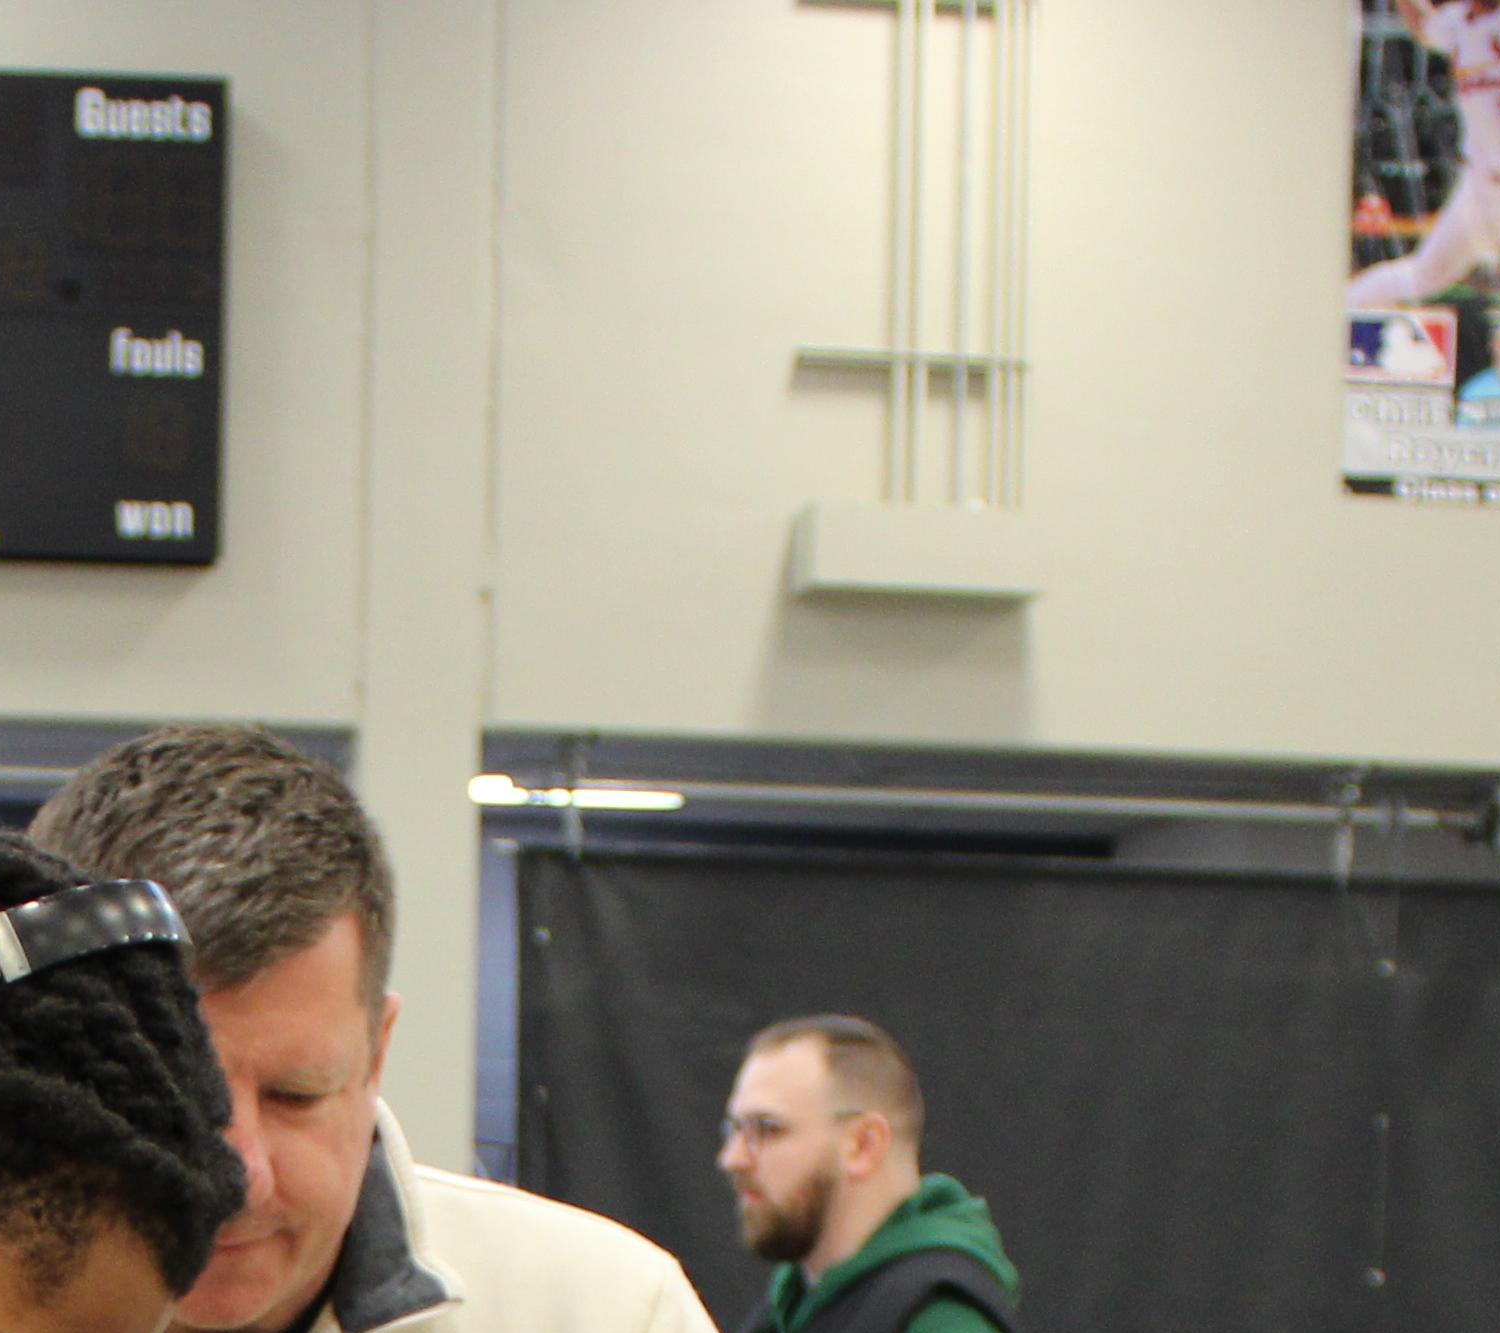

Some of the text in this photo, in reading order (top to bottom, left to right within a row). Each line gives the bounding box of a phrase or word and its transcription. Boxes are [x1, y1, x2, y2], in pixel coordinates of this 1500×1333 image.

[75, 86, 212, 142] Guests
[109, 326, 203, 378] fouls
[115, 500, 195, 540] won
